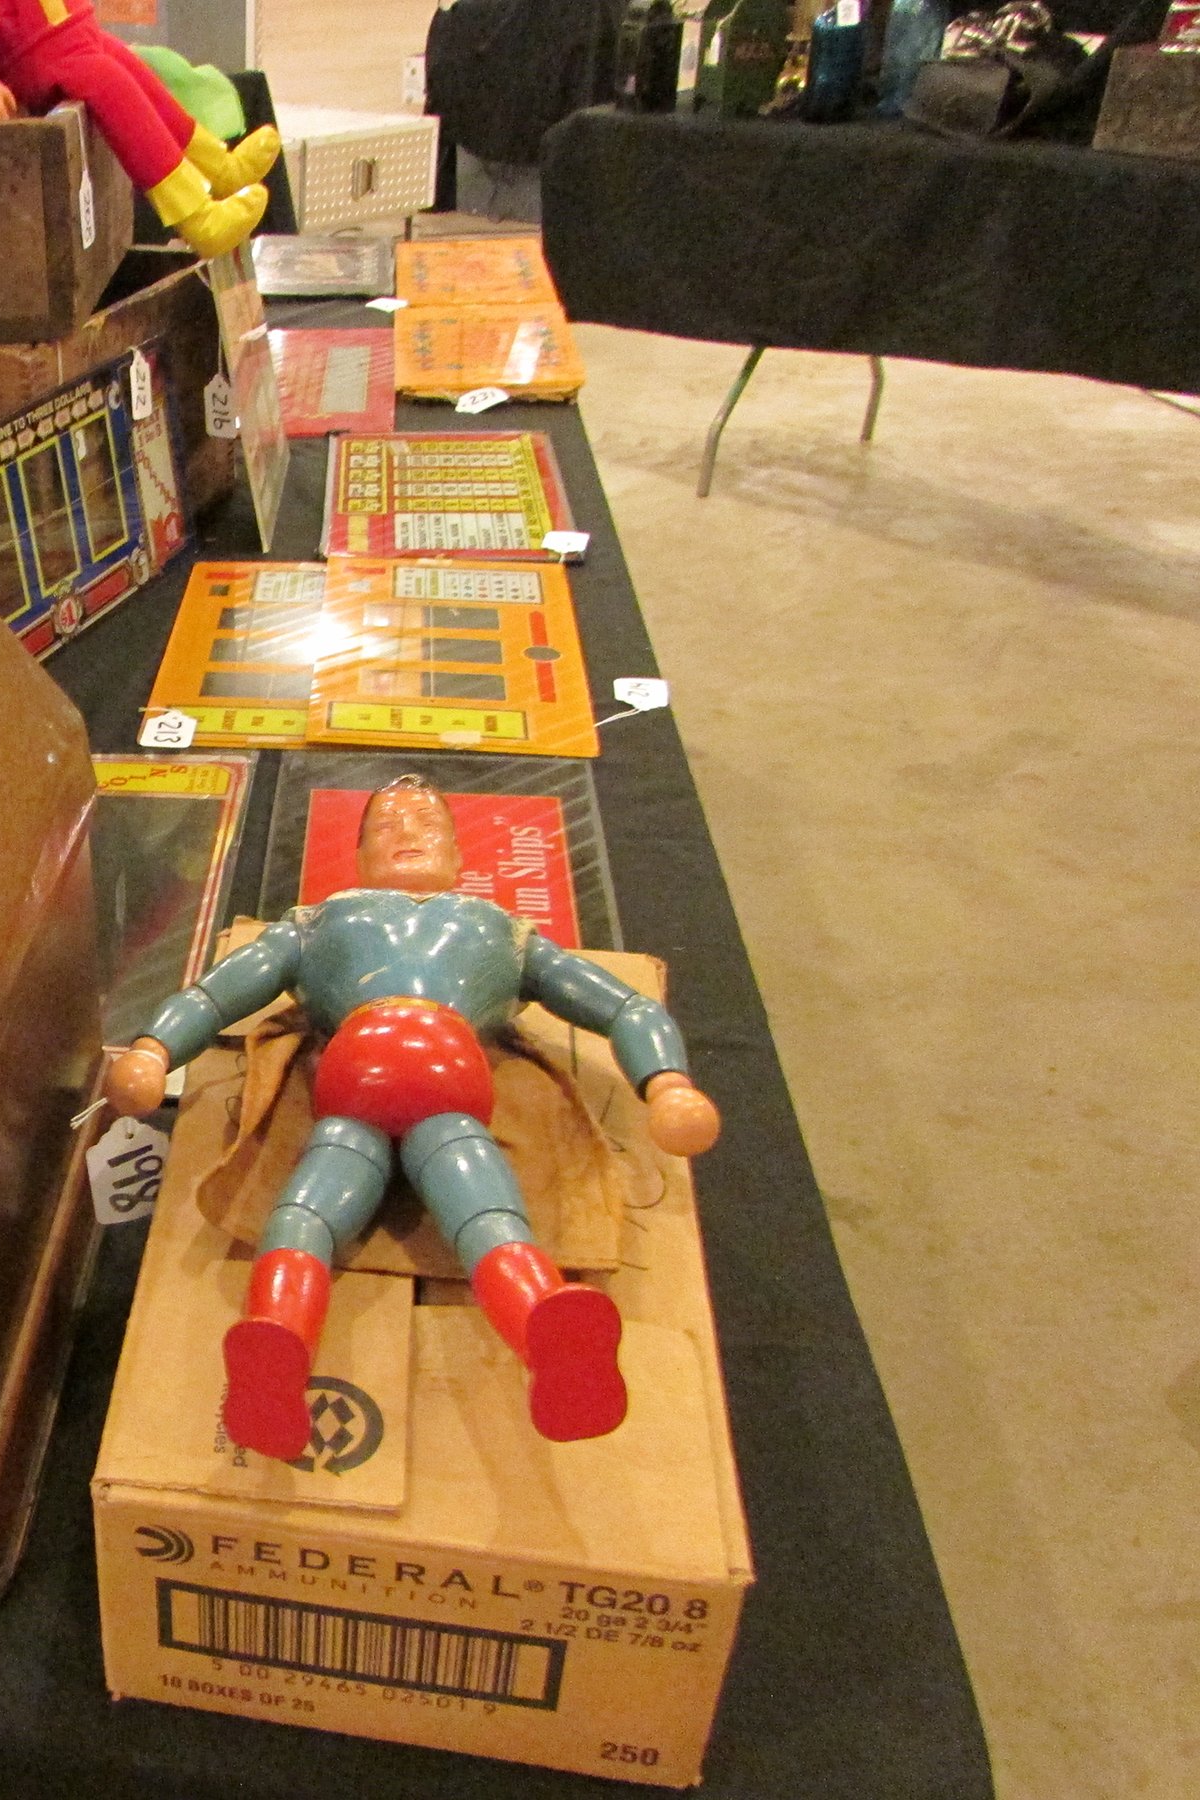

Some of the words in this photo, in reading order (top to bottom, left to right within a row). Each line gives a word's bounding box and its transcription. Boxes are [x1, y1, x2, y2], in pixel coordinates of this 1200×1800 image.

[134, 370, 148, 410] 212
[13, 418, 27, 433] TO
[211, 392, 231, 430] 216
[153, 720, 183, 744] 213
[107, 1143, 163, 1213] 198
[209, 1560, 479, 1611] AMMUNITION
[558, 1580, 671, 1617] TG20
[683, 1597, 709, 1620] 8
[519, 1618, 535, 1631] 2
[544, 1621, 578, 1639] 1/2
[585, 1626, 621, 1643] DE
[626, 1631, 666, 1649] 7/8
[670, 1640, 703, 1653] oz
[560, 1605, 590, 1622] 20
[634, 1616, 649, 1630] 2
[187, 1677, 254, 1703] BOXES
[258, 1688, 286, 1705] OF
[210, 1657, 222, 1672] 5
[237, 1662, 272, 1682] 00
[283, 1669, 368, 1697] 29465
[599, 1741, 662, 1768] 250
